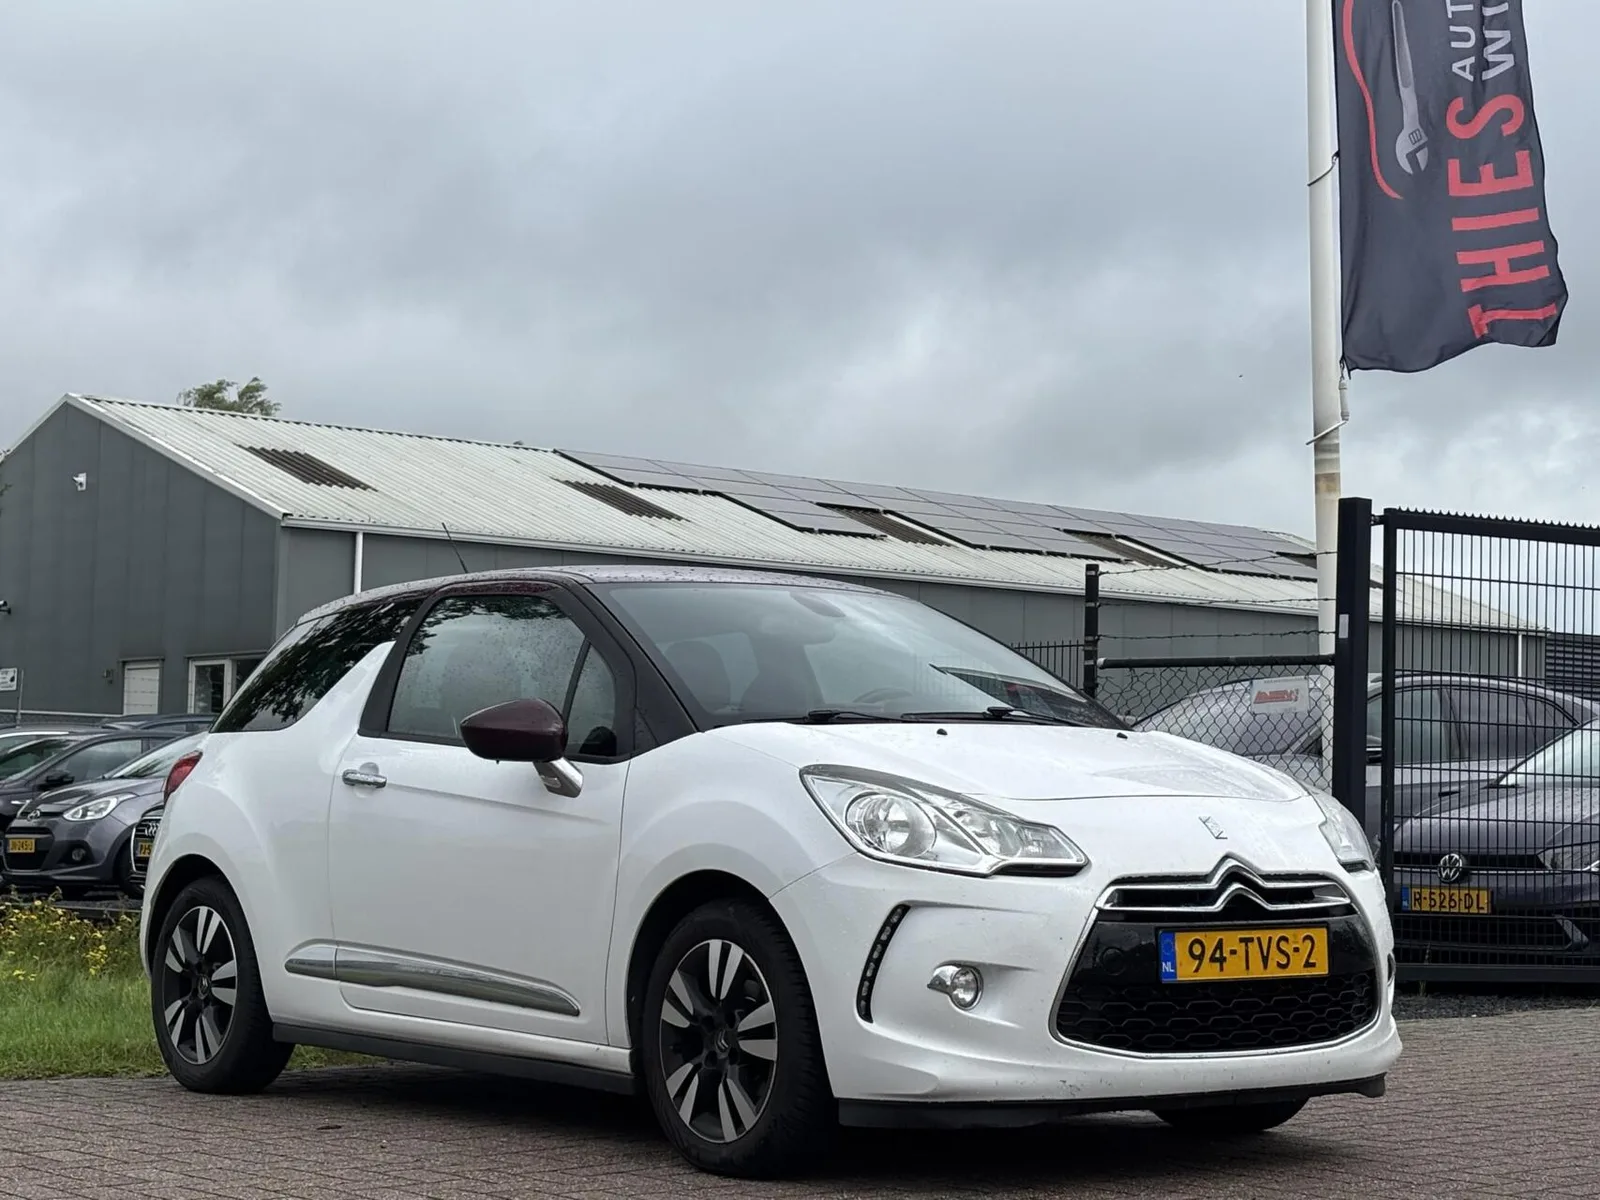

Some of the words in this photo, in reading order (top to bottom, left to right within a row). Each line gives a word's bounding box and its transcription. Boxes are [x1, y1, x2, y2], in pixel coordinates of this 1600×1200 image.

[1445, 0, 1476, 82] AUT
[1446, 94, 1557, 339] THIES
[1413, 891, 1485, 910] R-526-DL
[1162, 961, 1175, 973] NL
[1188, 934, 1317, 973] 94-TVS-2
